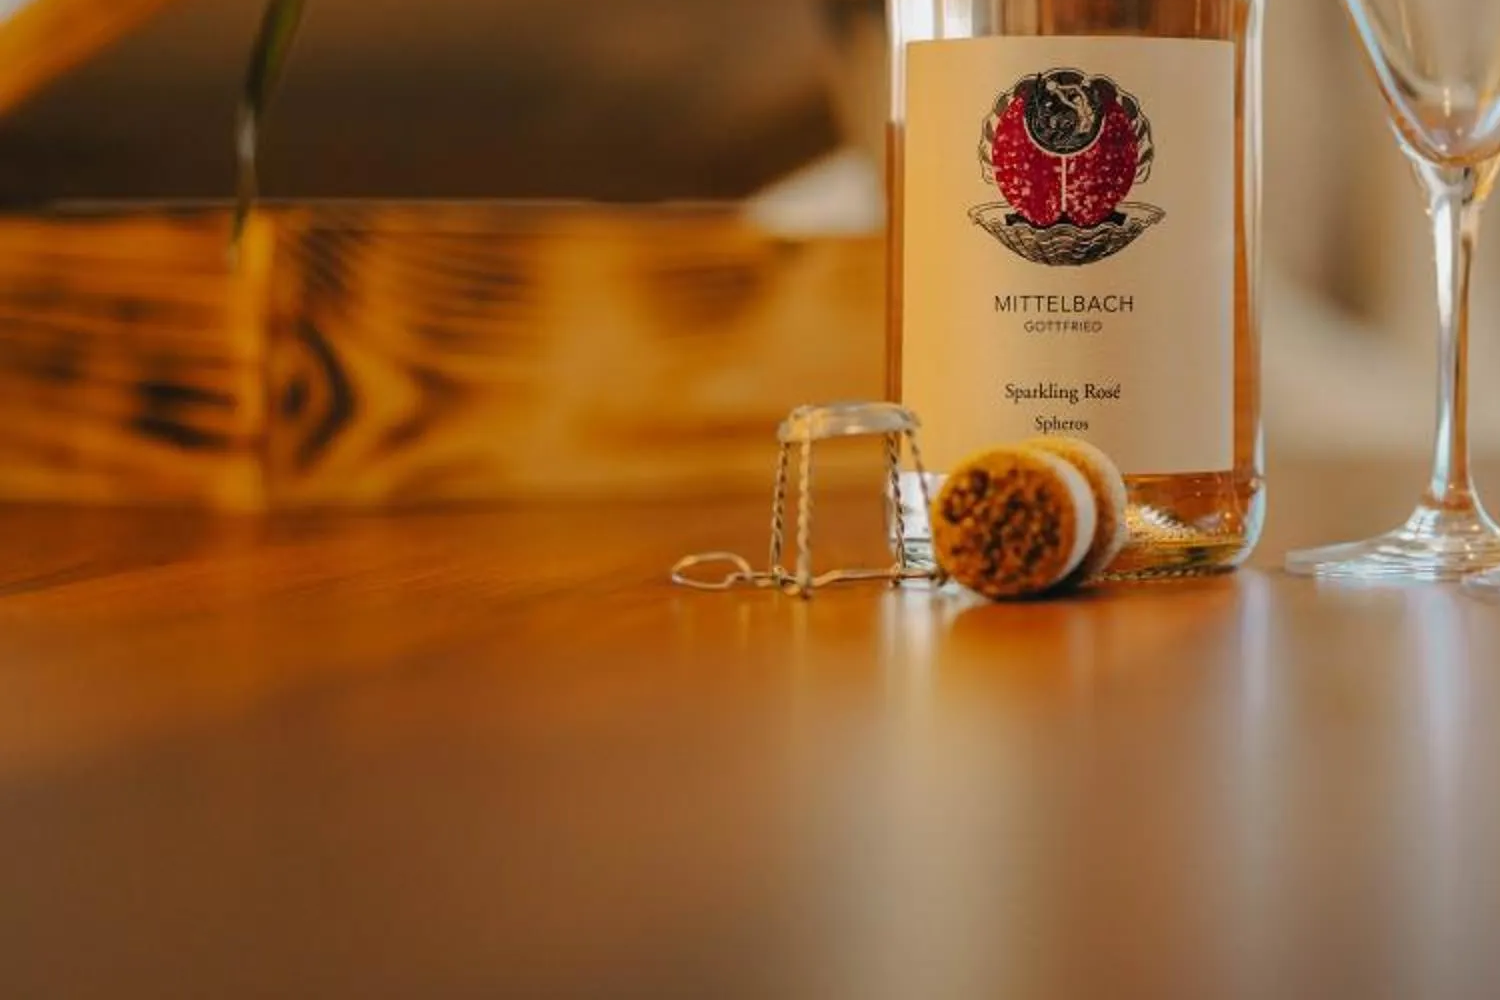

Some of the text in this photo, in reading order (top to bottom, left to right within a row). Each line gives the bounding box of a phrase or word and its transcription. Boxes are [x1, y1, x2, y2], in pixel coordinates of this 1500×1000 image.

[994, 295, 1134, 313] MITTELBACH
[1023, 320, 1103, 334] GOTTFRIED
[1004, 382, 1122, 405] Sparkling Rosé
[1034, 415, 1089, 434] Spheros
